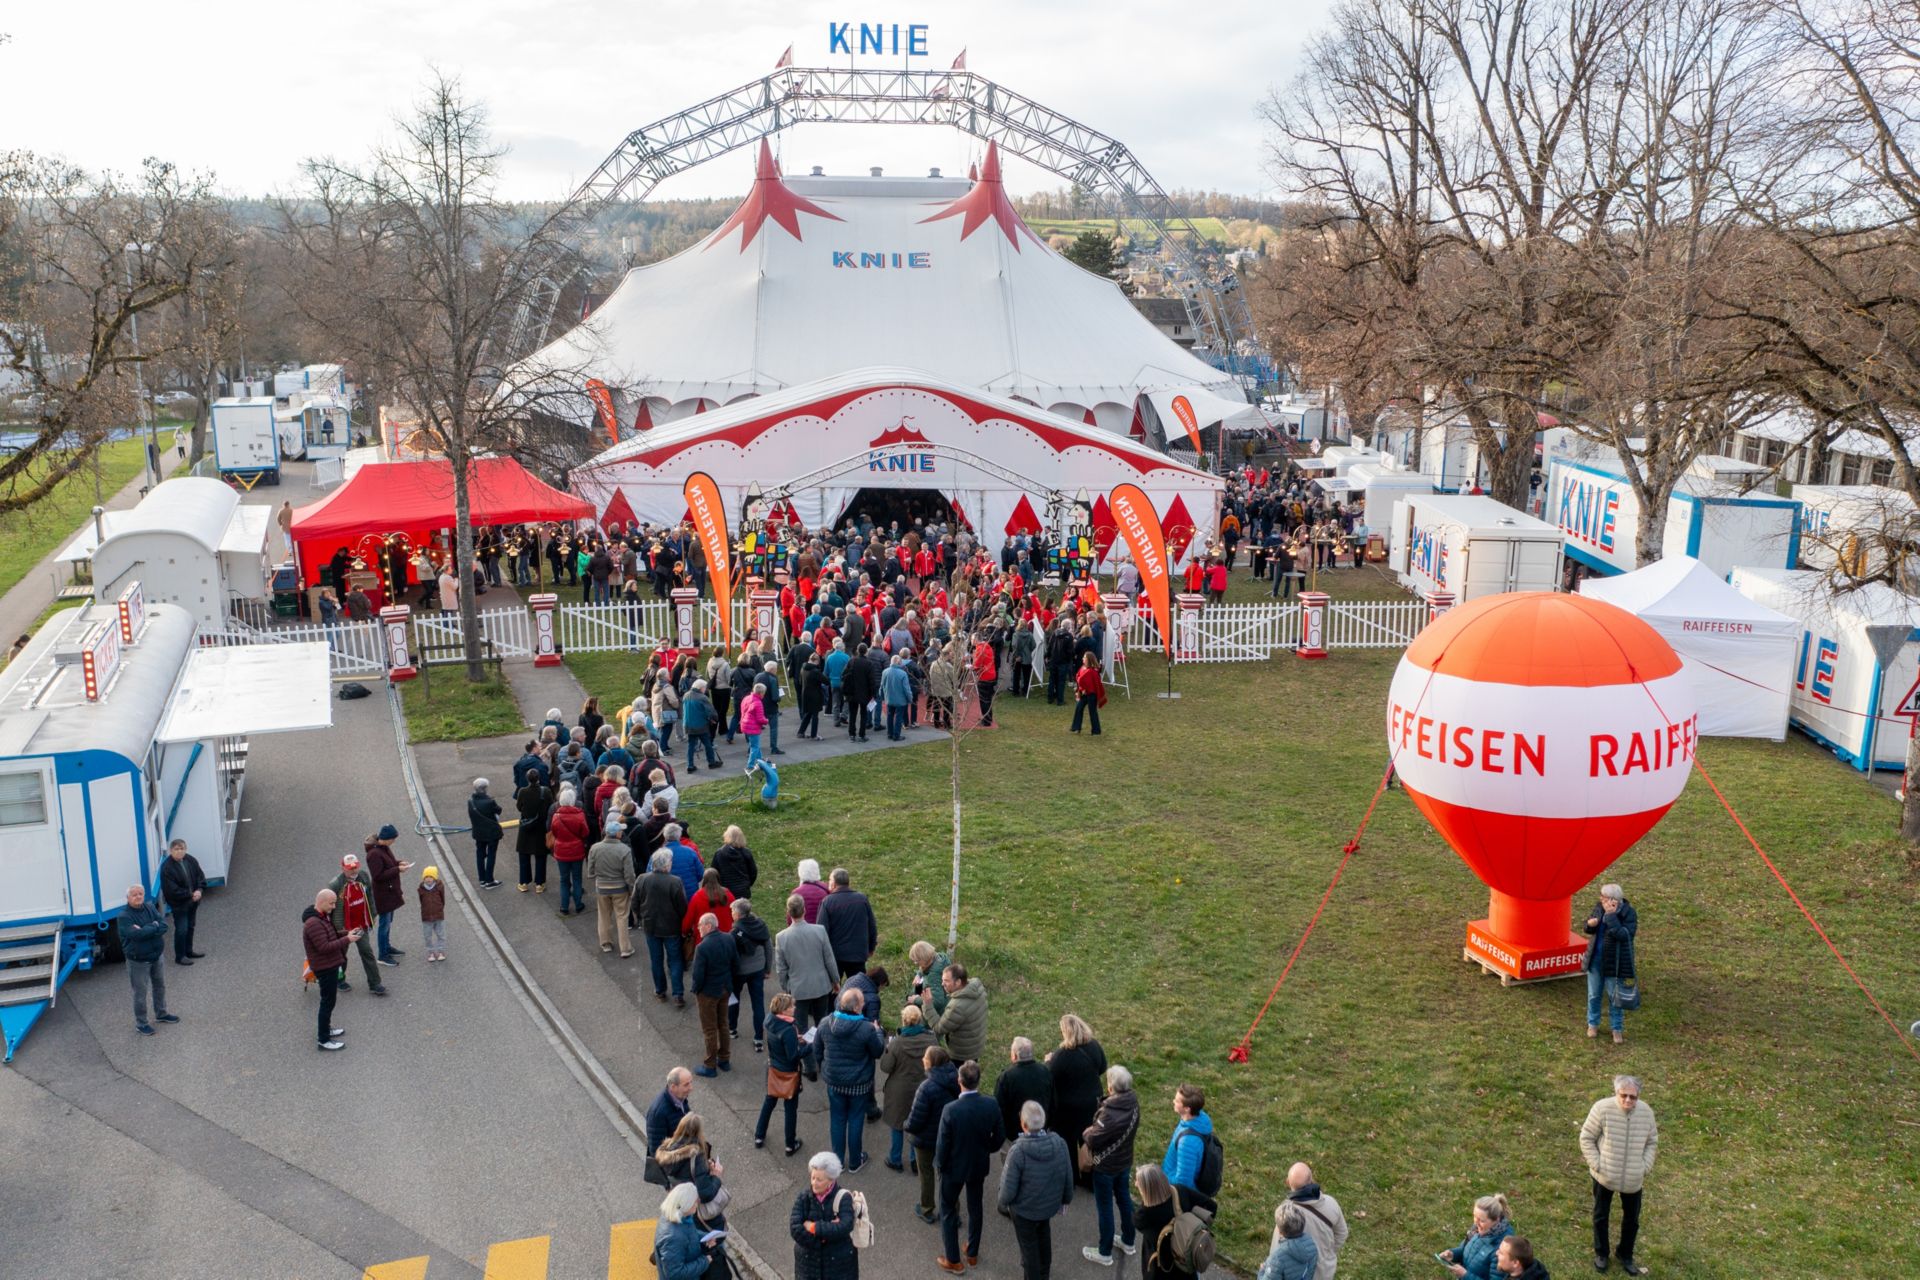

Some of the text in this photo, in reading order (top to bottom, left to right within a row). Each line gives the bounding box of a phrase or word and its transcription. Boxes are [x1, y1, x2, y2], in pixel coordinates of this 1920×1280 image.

[829, 21, 929, 56] KNIE
[832, 251, 932, 269] KNIE
[868, 451, 936, 472] KNIE
[774, 484, 794, 543] KNIE
[1043, 489, 1064, 547] KNIE
[1558, 475, 1620, 555] KNIE
[1411, 526, 1448, 589] KNIE
[1682, 620, 1753, 634] RAIFFEISEN
[1470, 933, 1517, 969] RAIFFEISEN
[1525, 952, 1585, 972] RAIFFEISEN
